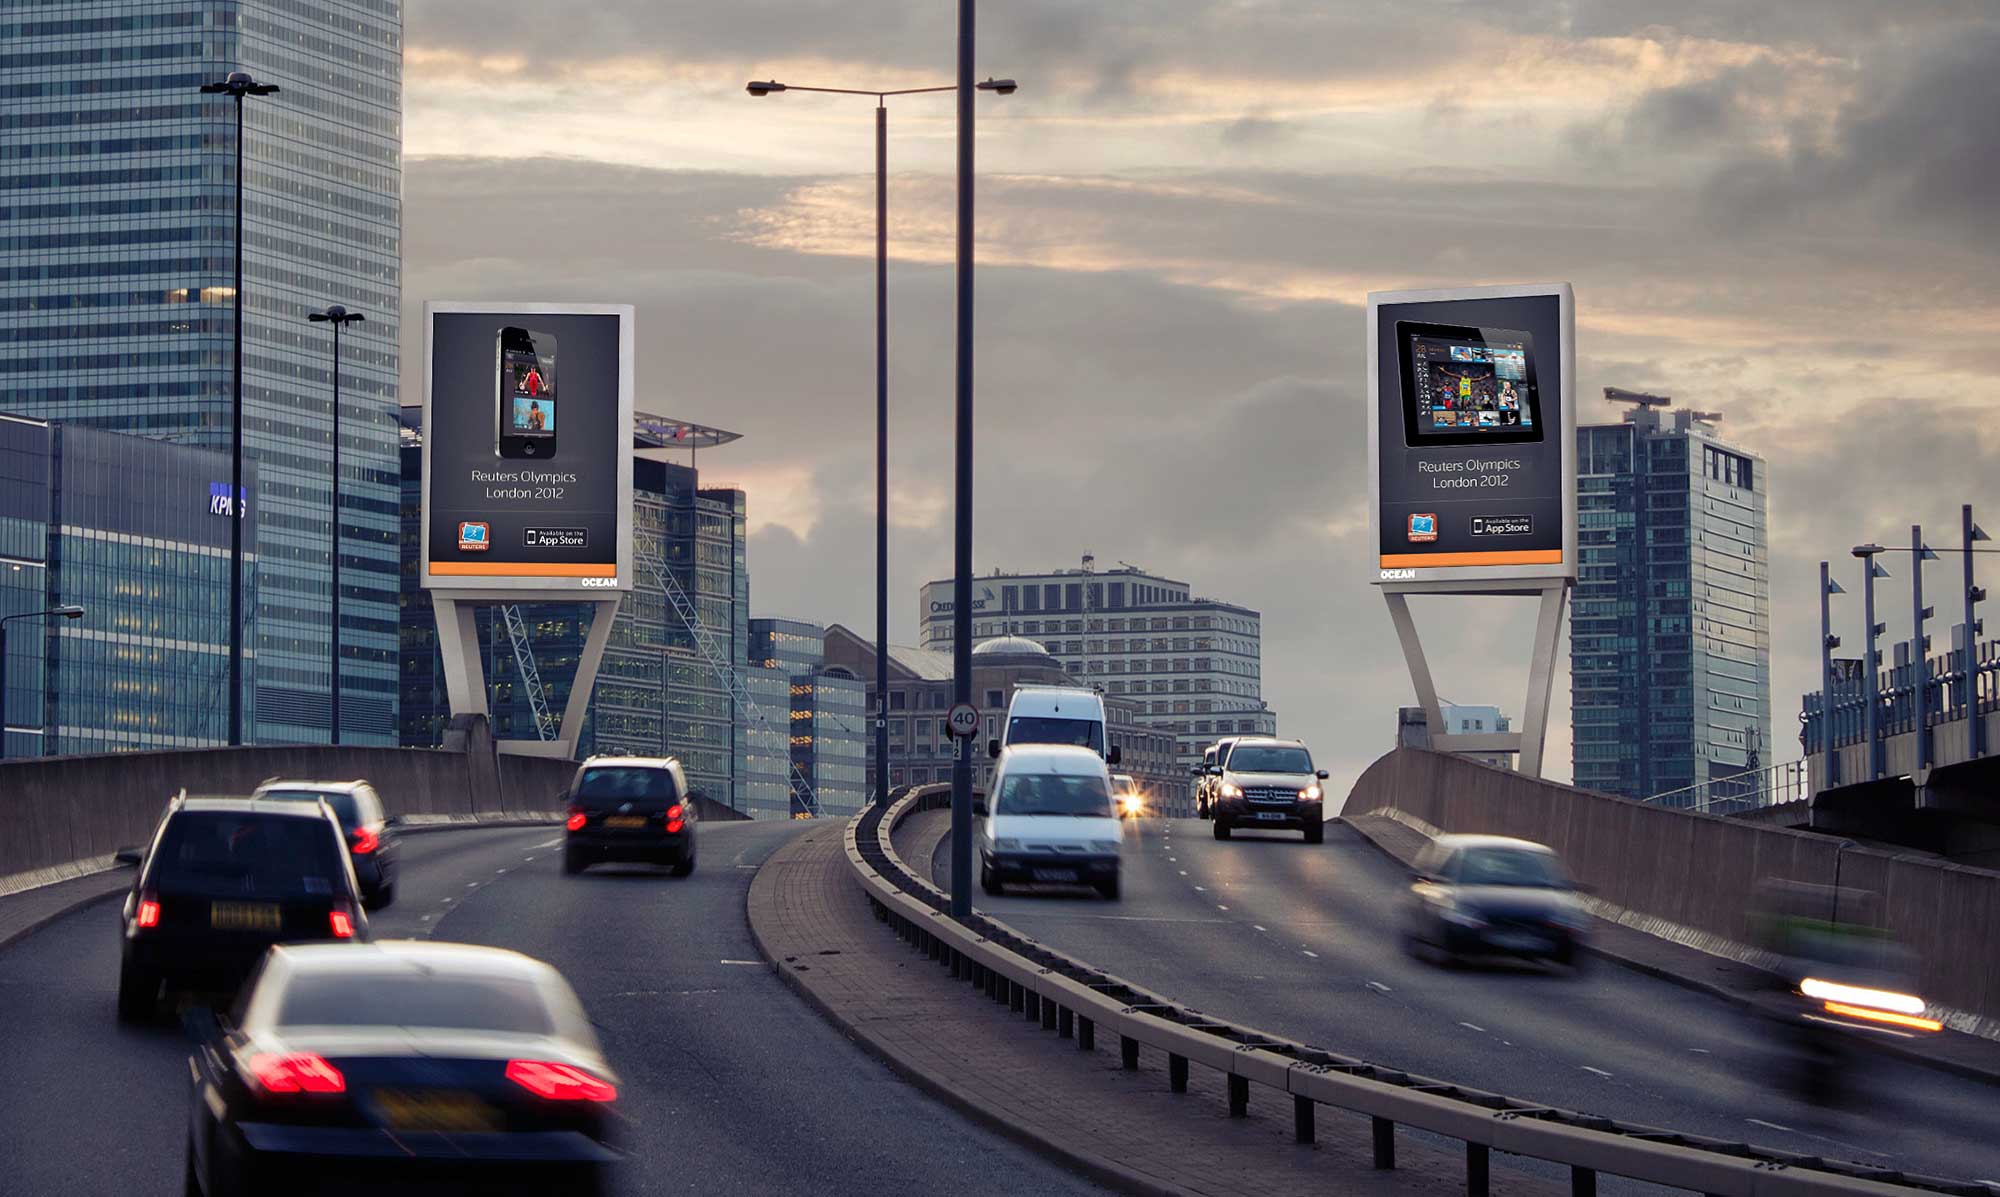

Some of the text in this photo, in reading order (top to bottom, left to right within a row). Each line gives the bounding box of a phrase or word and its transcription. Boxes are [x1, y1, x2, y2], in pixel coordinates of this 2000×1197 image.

[1418, 459, 1521, 473] Reuters Olympics
[471, 470, 577, 485] Reuters Olympics
[1433, 475, 1509, 489] London 2012
[486, 487, 564, 499] London 2012
[1485, 523, 1530, 534] App Store
[538, 536, 584, 546] App Store
[1380, 569, 1416, 580] OCEAN
[581, 577, 618, 587] OCEAN
[953, 712, 976, 725] 40
